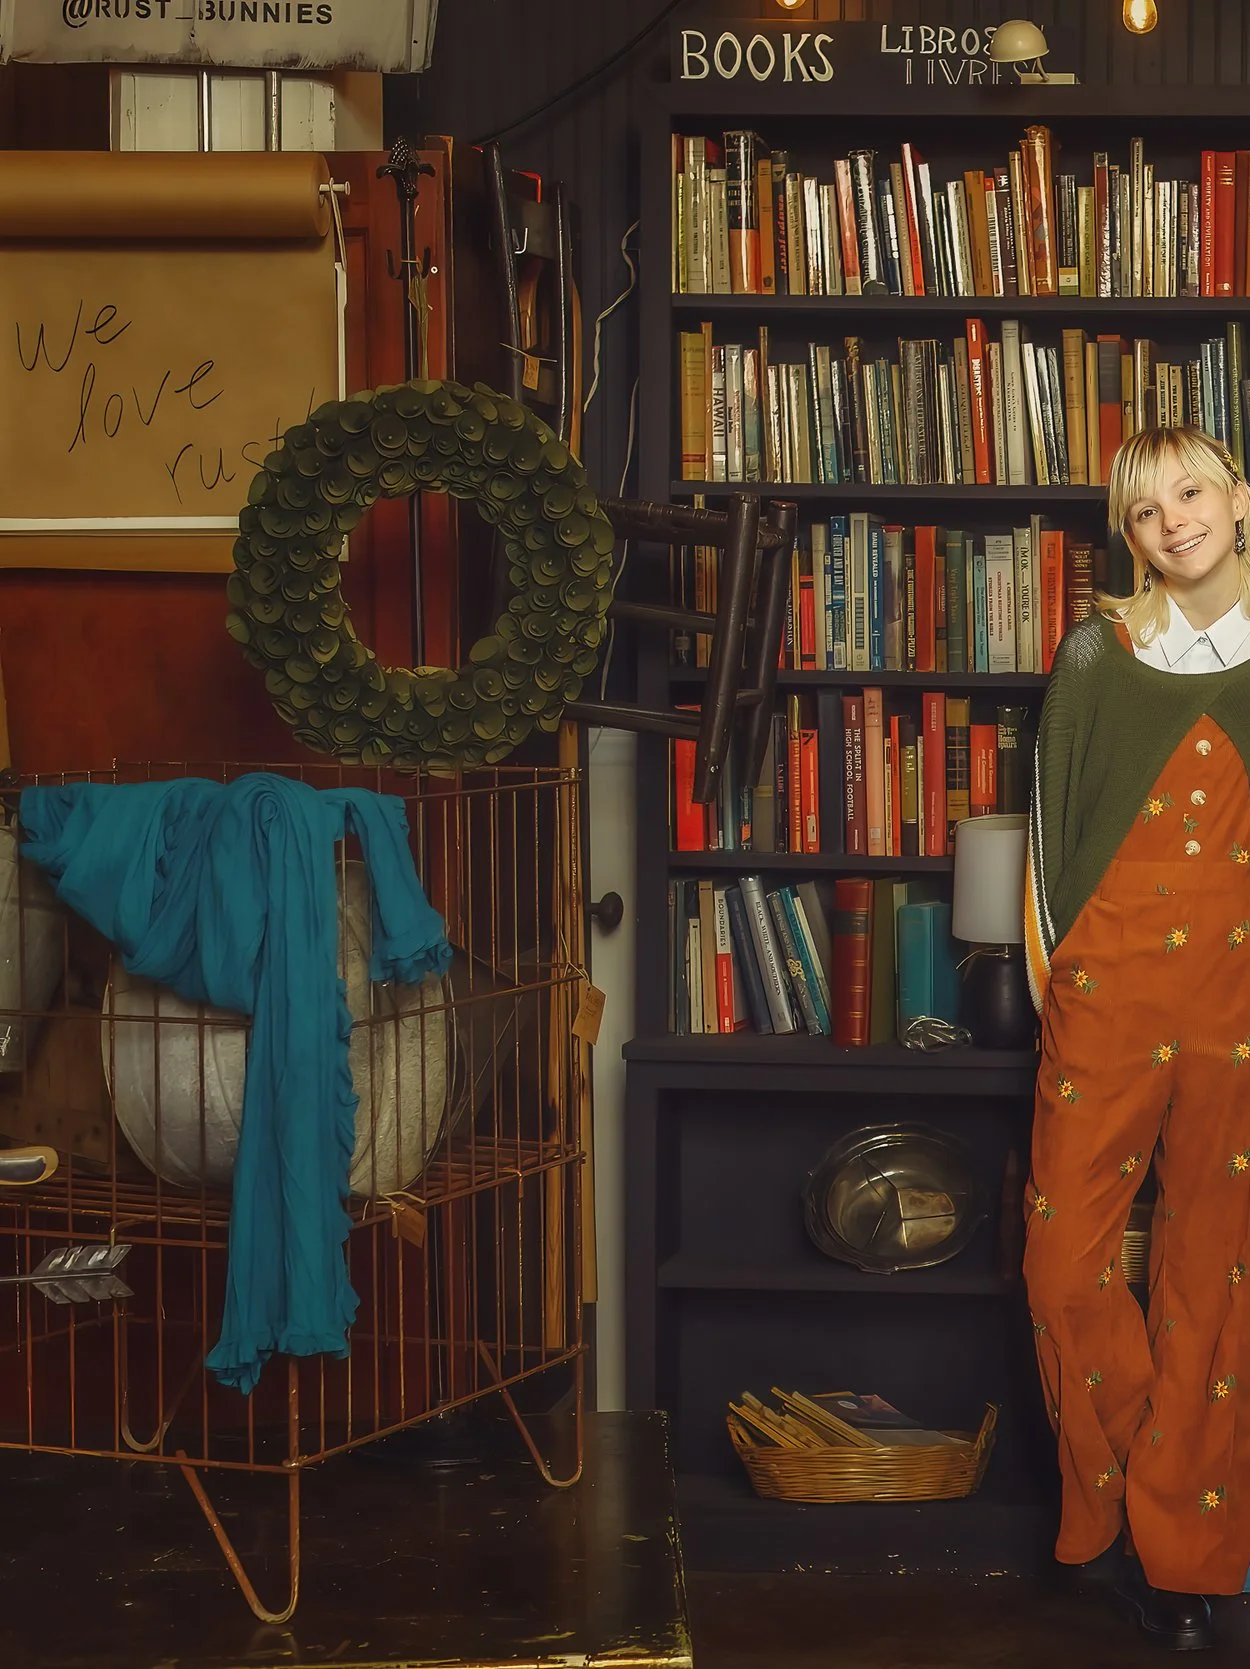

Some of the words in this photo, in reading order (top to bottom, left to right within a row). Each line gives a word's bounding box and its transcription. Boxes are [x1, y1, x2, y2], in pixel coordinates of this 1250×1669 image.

[680, 29, 834, 82] BOOKS
[69, 360, 224, 453] love
[713, 387, 724, 437] HAWAII
[718, 899, 726, 947] BOUNDARIES
